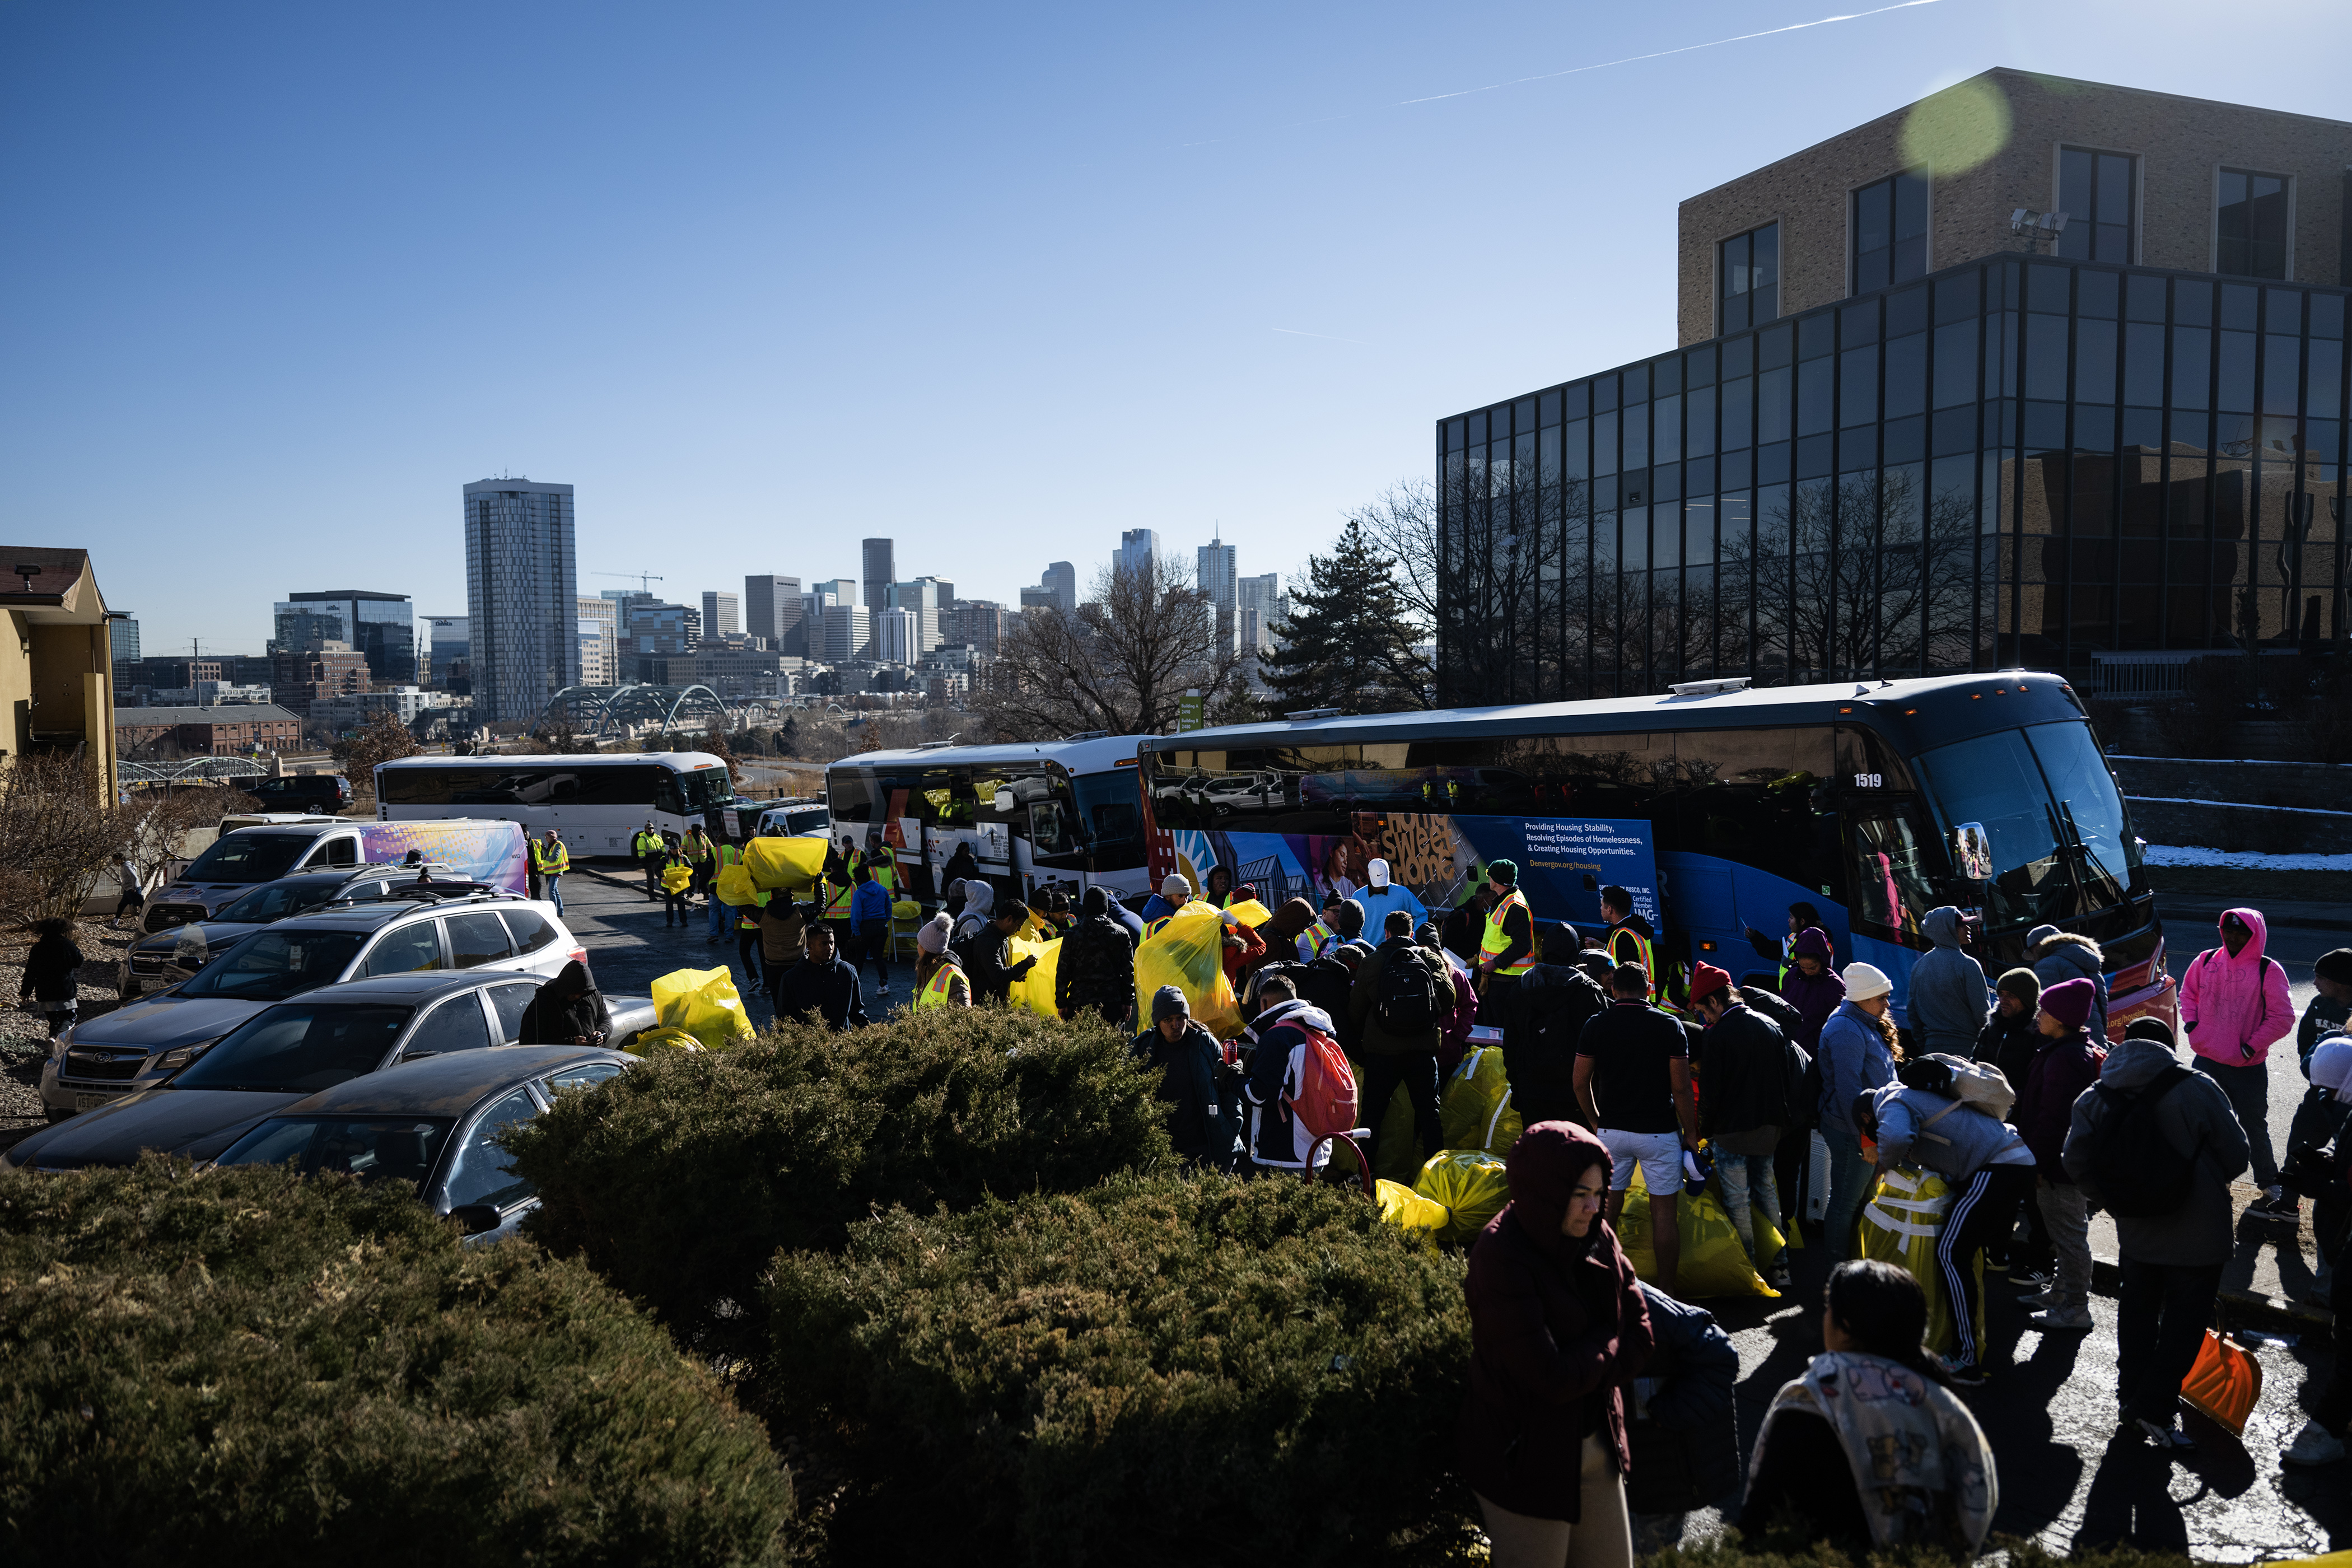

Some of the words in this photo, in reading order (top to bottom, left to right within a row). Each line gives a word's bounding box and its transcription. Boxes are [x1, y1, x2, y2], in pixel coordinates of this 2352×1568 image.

[1854, 773, 1882, 787] 1519
[1525, 823, 1554, 832] Providing
[1556, 824, 1582, 833] Housing
[1584, 824, 1614, 833] Stability,
[1527, 834, 1555, 843] Resolving
[1556, 835, 1584, 843] Episodes
[1593, 836, 1642, 844] Homelessness,
[1534, 845, 1560, 854] Creating
[1561, 846, 1586, 855] Housing
[1588, 847, 1636, 856] Opportunities.
[1392, 848, 1455, 886] Home
[1530, 860, 1601, 871] Denvergov.org/housing
